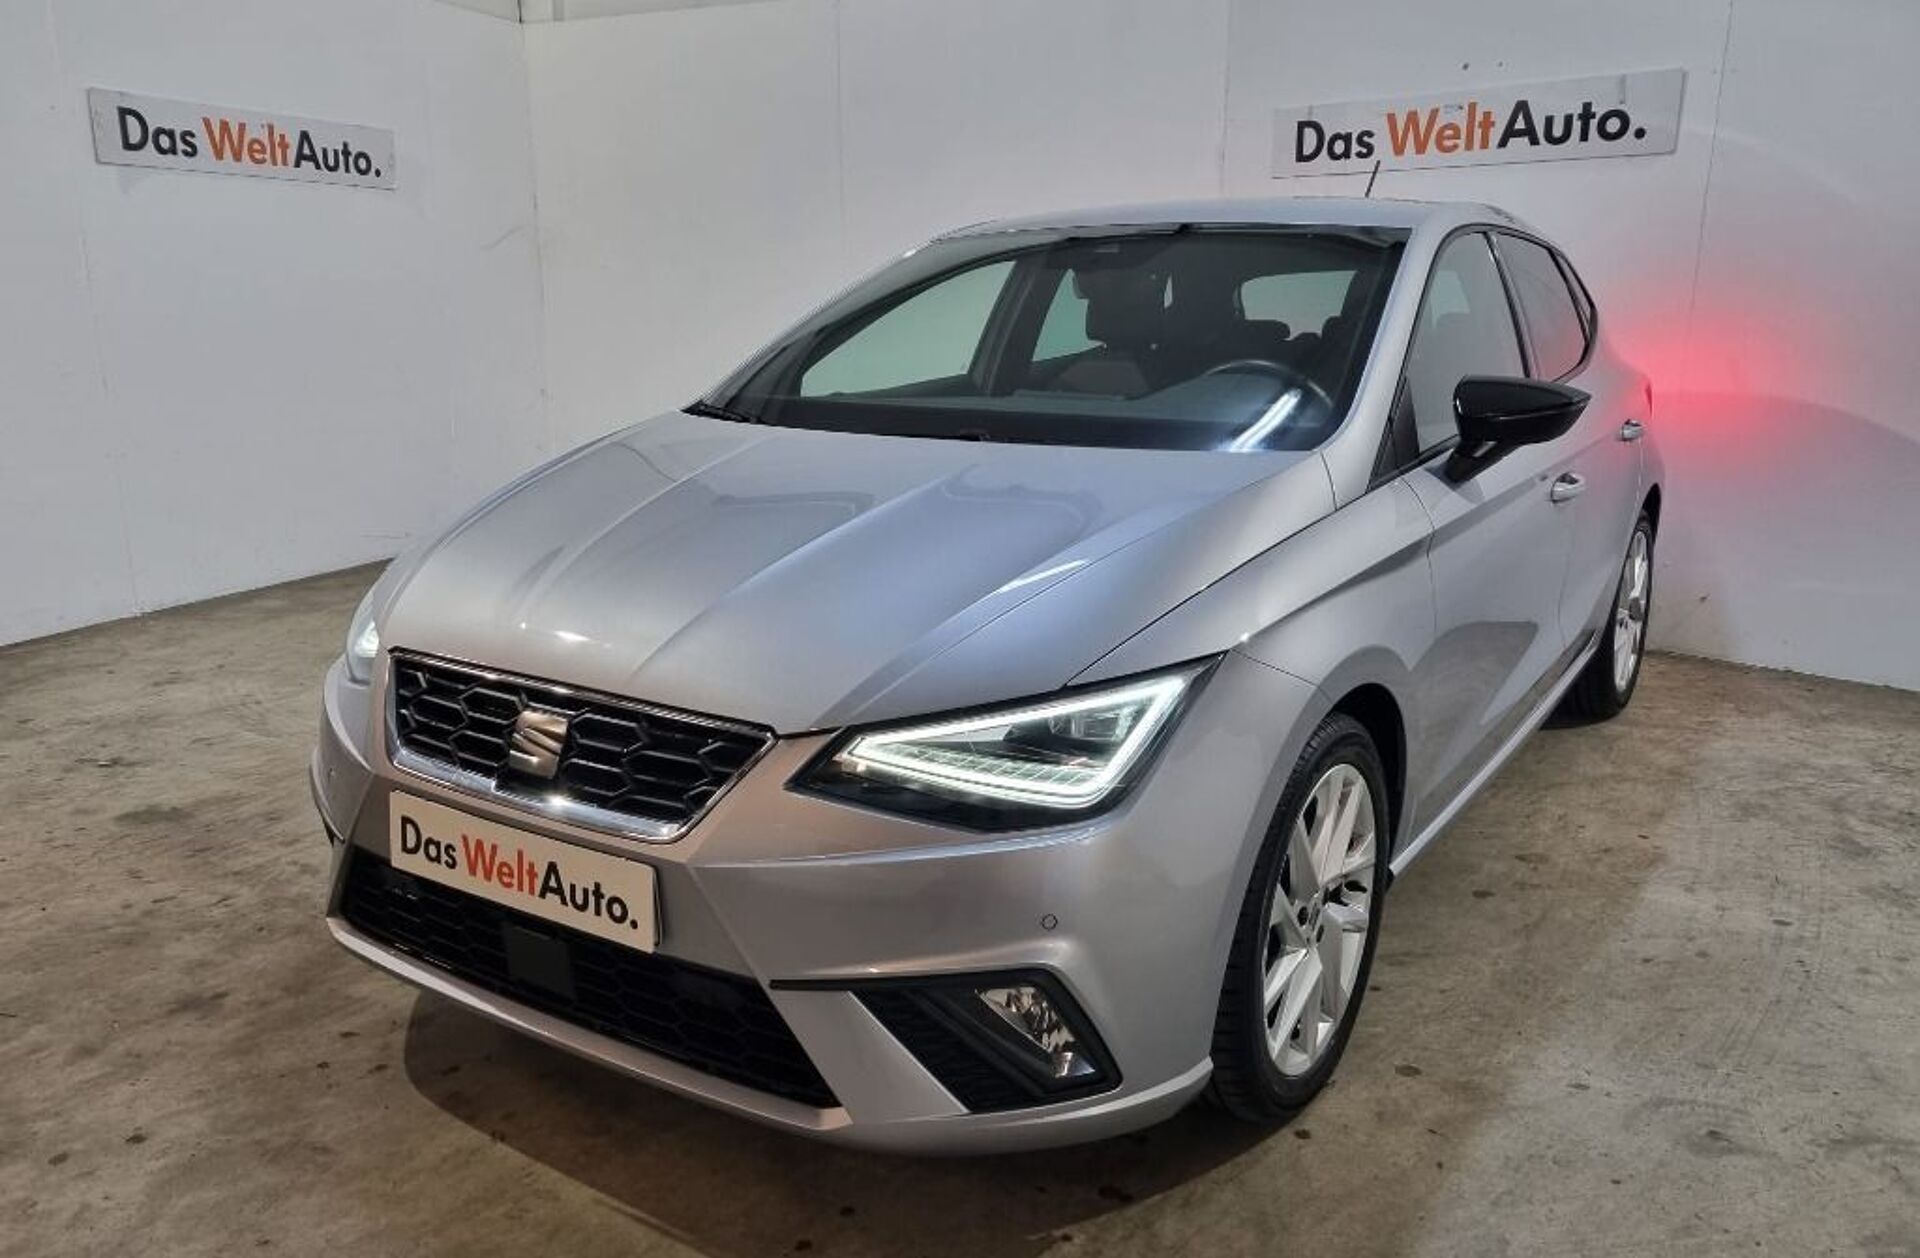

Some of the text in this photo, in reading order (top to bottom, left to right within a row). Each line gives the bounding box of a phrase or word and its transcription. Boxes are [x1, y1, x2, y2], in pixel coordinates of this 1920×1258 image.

[117, 105, 198, 158] Das
[1295, 120, 1375, 163] Das
[400, 815, 457, 869] Das
